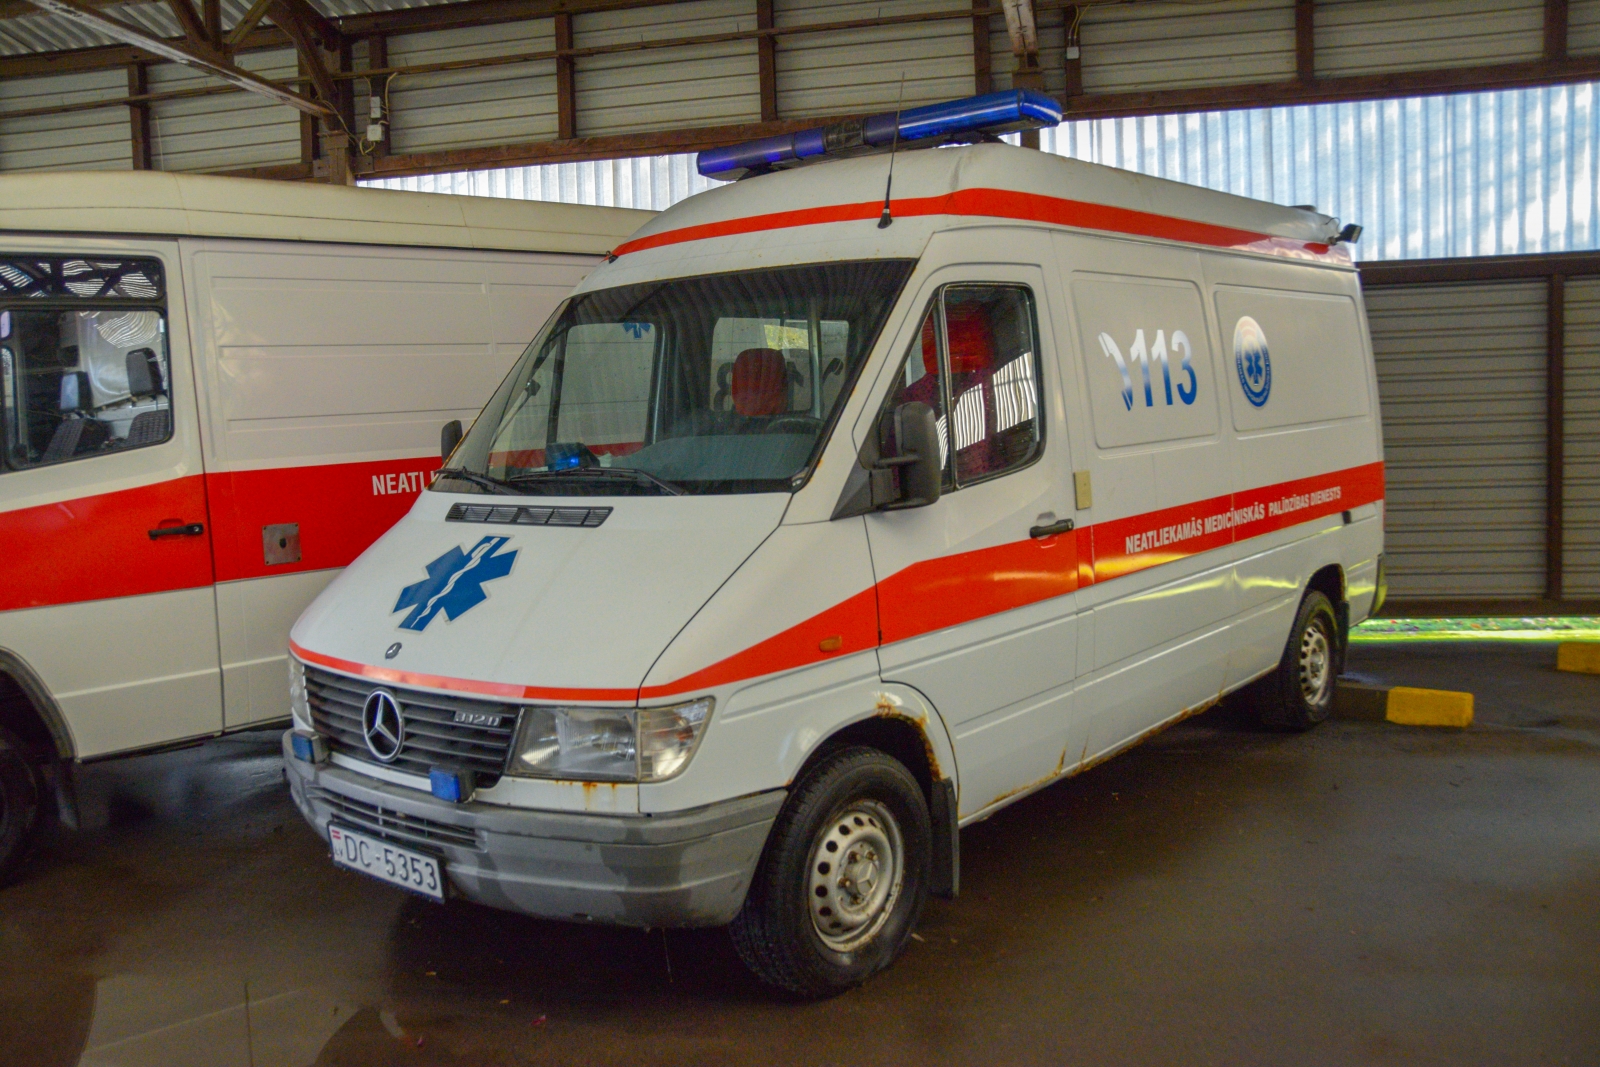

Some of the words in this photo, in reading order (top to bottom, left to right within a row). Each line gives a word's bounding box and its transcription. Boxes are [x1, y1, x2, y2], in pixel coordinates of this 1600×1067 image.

[1130, 329, 1197, 407] 113
[1125, 517, 1202, 555] NEATLIEKAMĀS
[1204, 502, 1265, 534] MEDICĪNISKĀS
[1268, 494, 1309, 517] PALĪDZĪBAS
[1310, 486, 1341, 506] DIENESTS
